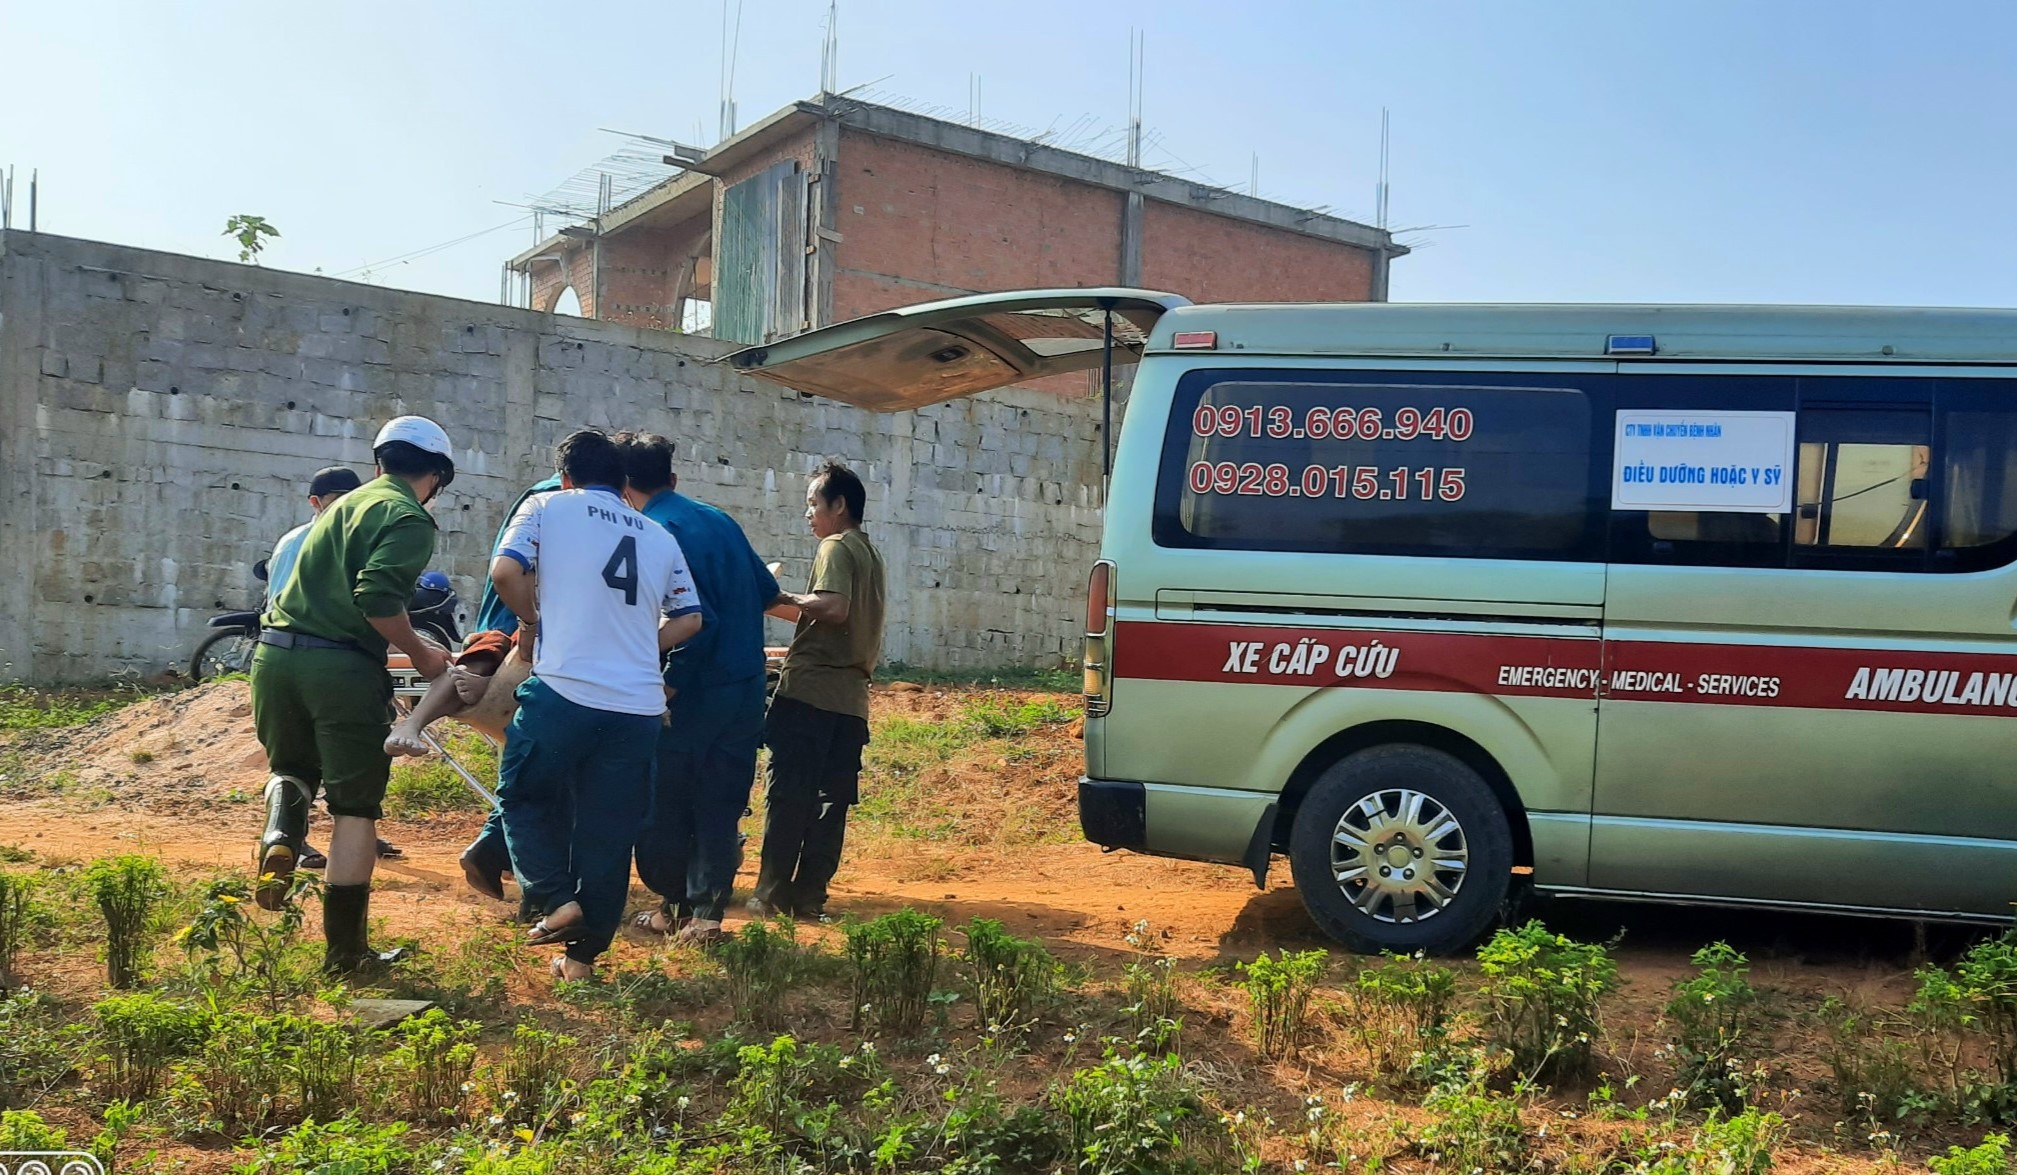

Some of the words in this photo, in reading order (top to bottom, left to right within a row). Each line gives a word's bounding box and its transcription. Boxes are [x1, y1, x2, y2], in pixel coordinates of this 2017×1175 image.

[1192, 404, 1473, 441] 0913.666.940
[1189, 461, 1466, 501] 0928.015.115
[1623, 459, 1654, 483] ĐIỀU
[1660, 463, 1705, 484] DƯỠNG
[1710, 465, 1746, 488] HOẶC
[1752, 467, 1760, 485] Y
[1764, 464, 1782, 485] SỸ
[587, 505, 618, 524] PHI
[601, 535, 638, 606] 4
[1222, 641, 1264, 673] XE
[1268, 637, 1330, 675] CẤP
[1335, 639, 1400, 679] CỨU
[1497, 665, 1600, 690] EMERGENCY
[1610, 670, 1684, 693] MEDICAL
[1696, 673, 1780, 697] SERVICES
